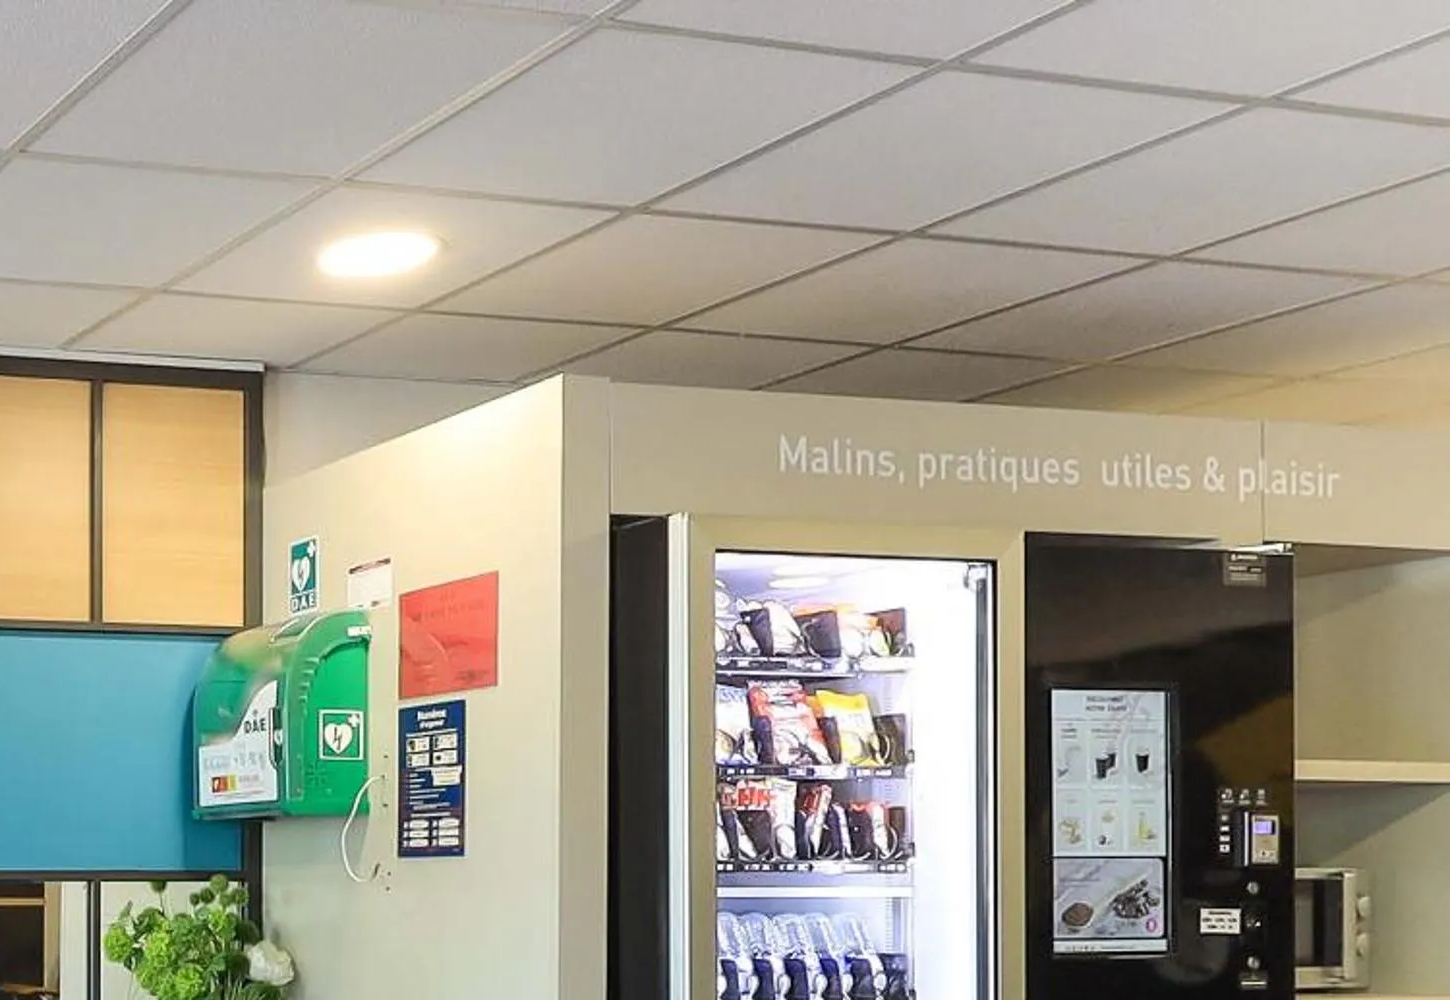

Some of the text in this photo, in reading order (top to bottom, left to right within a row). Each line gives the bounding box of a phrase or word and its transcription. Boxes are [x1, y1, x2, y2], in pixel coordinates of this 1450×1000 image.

[778, 434, 1341, 503] Malins, pratiques utiles & plaisir
[291, 592, 315, 612] DAE
[243, 717, 267, 734] DAE
